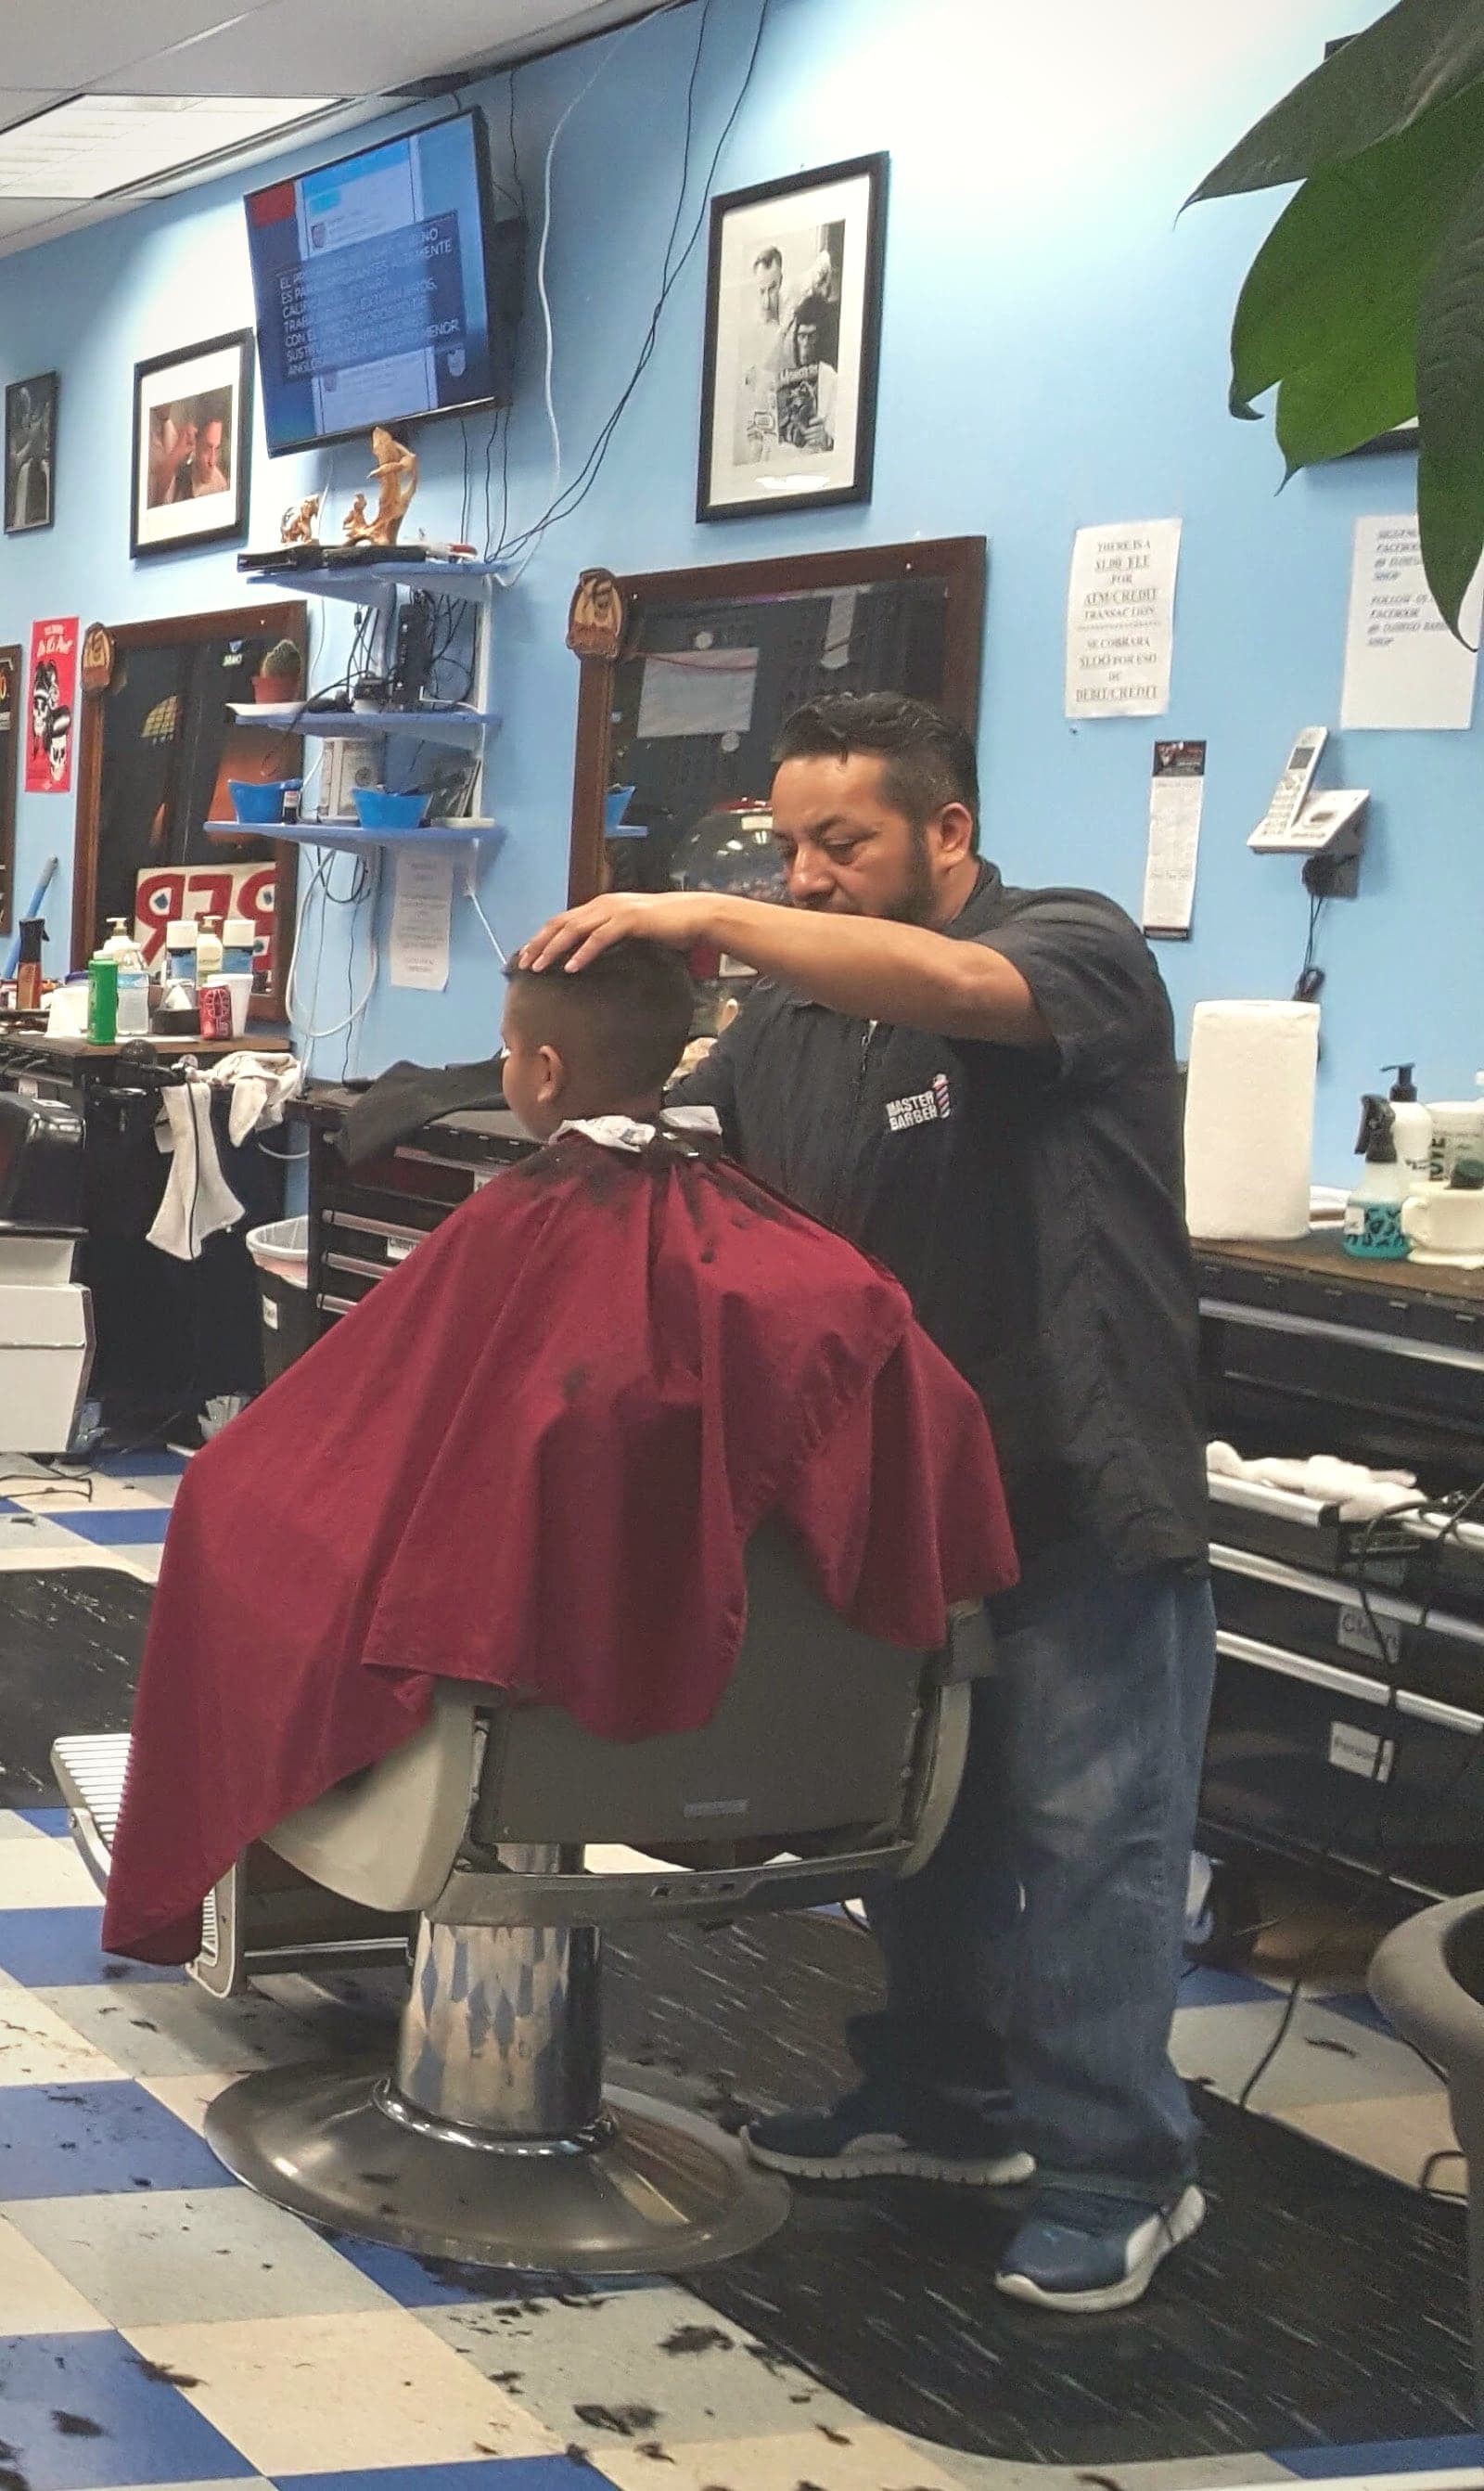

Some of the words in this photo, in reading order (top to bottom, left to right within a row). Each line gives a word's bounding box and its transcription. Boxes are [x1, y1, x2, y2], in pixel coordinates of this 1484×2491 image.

[1098, 542, 1130, 552] THERE
[1132, 540, 1144, 551] IS
[1110, 573, 1132, 584] FOR
[1084, 606, 1155, 619] TRANSACTION
[886, 1090, 935, 1116] MASTER
[889, 1104, 938, 1131] BARBER
